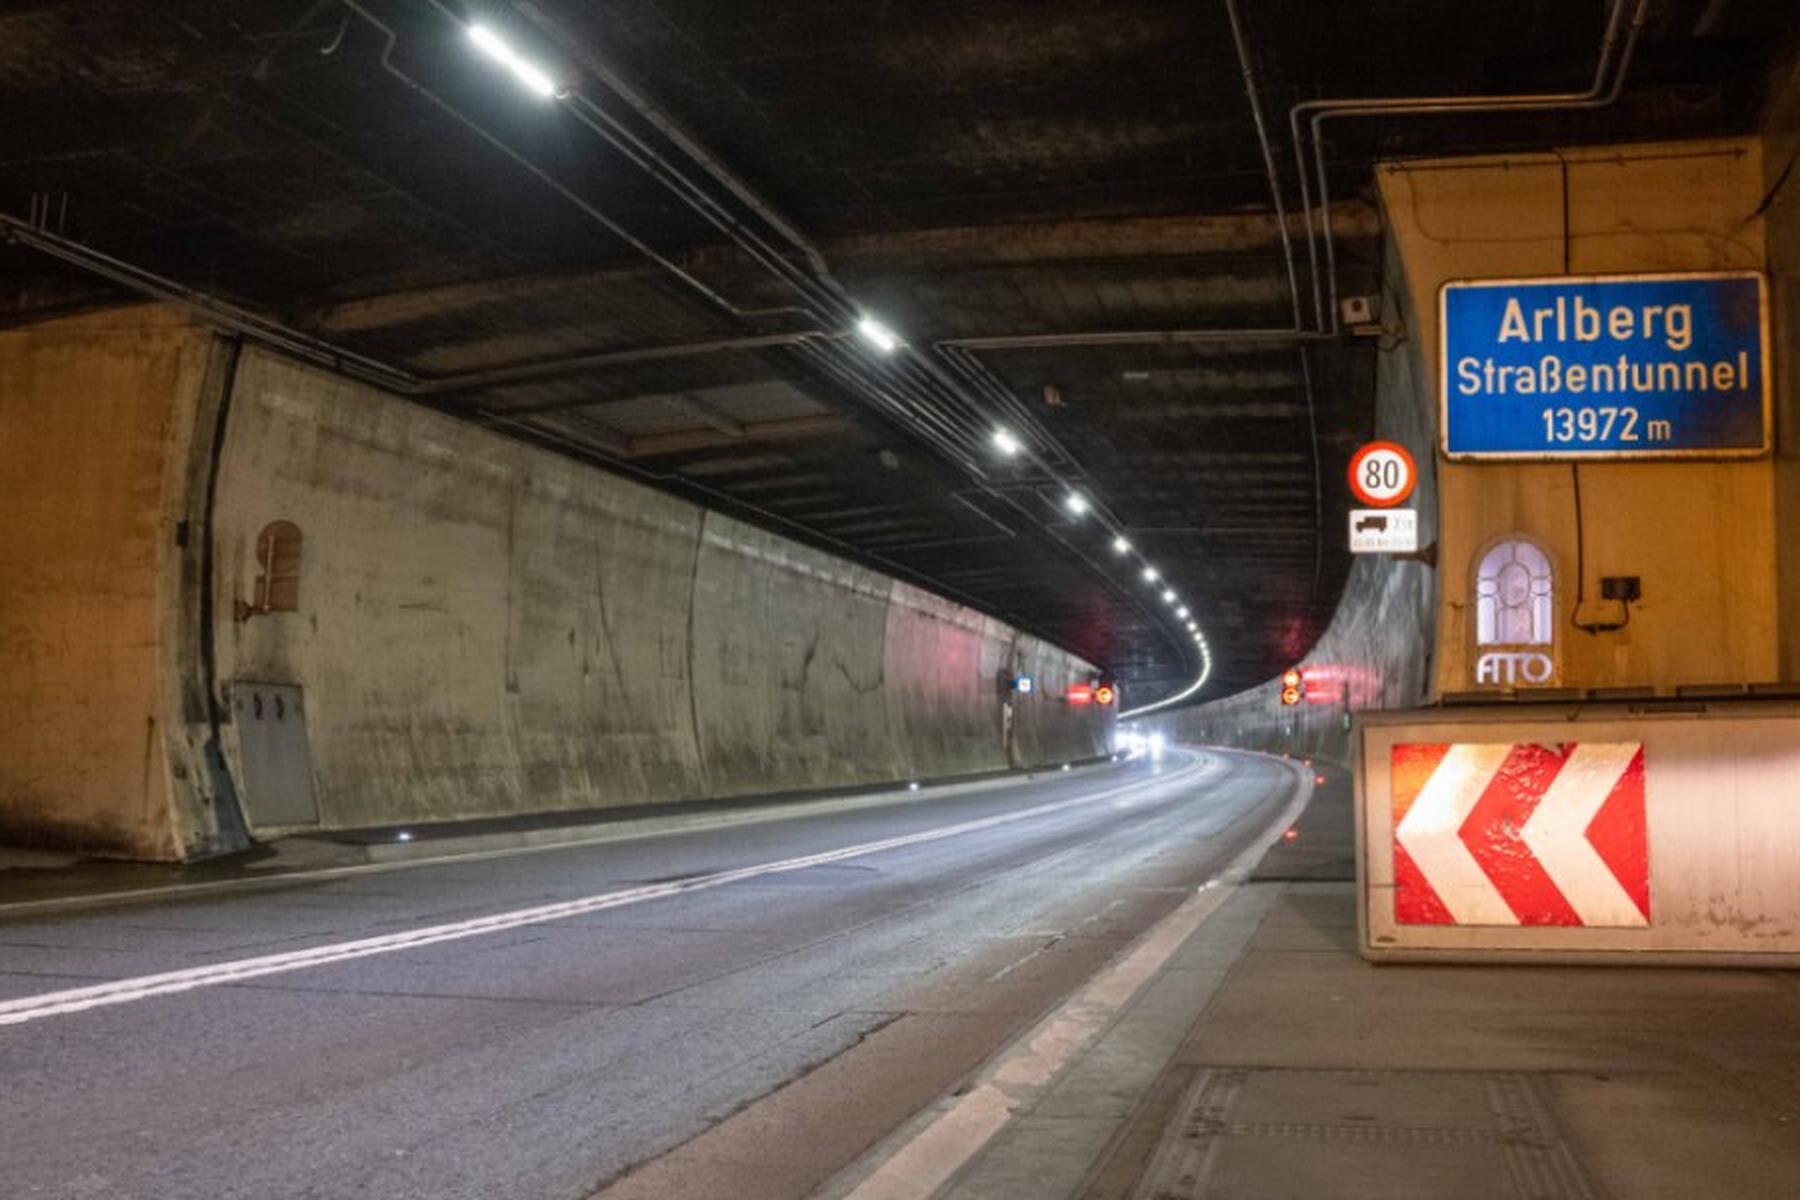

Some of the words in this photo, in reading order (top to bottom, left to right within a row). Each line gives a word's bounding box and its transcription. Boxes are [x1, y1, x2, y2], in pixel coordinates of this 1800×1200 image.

[1498, 296, 1692, 351] Arlberg
[1457, 351, 1748, 396] Straßentunnel
[1543, 407, 1639, 442] 13972
[1647, 419, 1671, 441] m
[1365, 459, 1400, 489] 80
